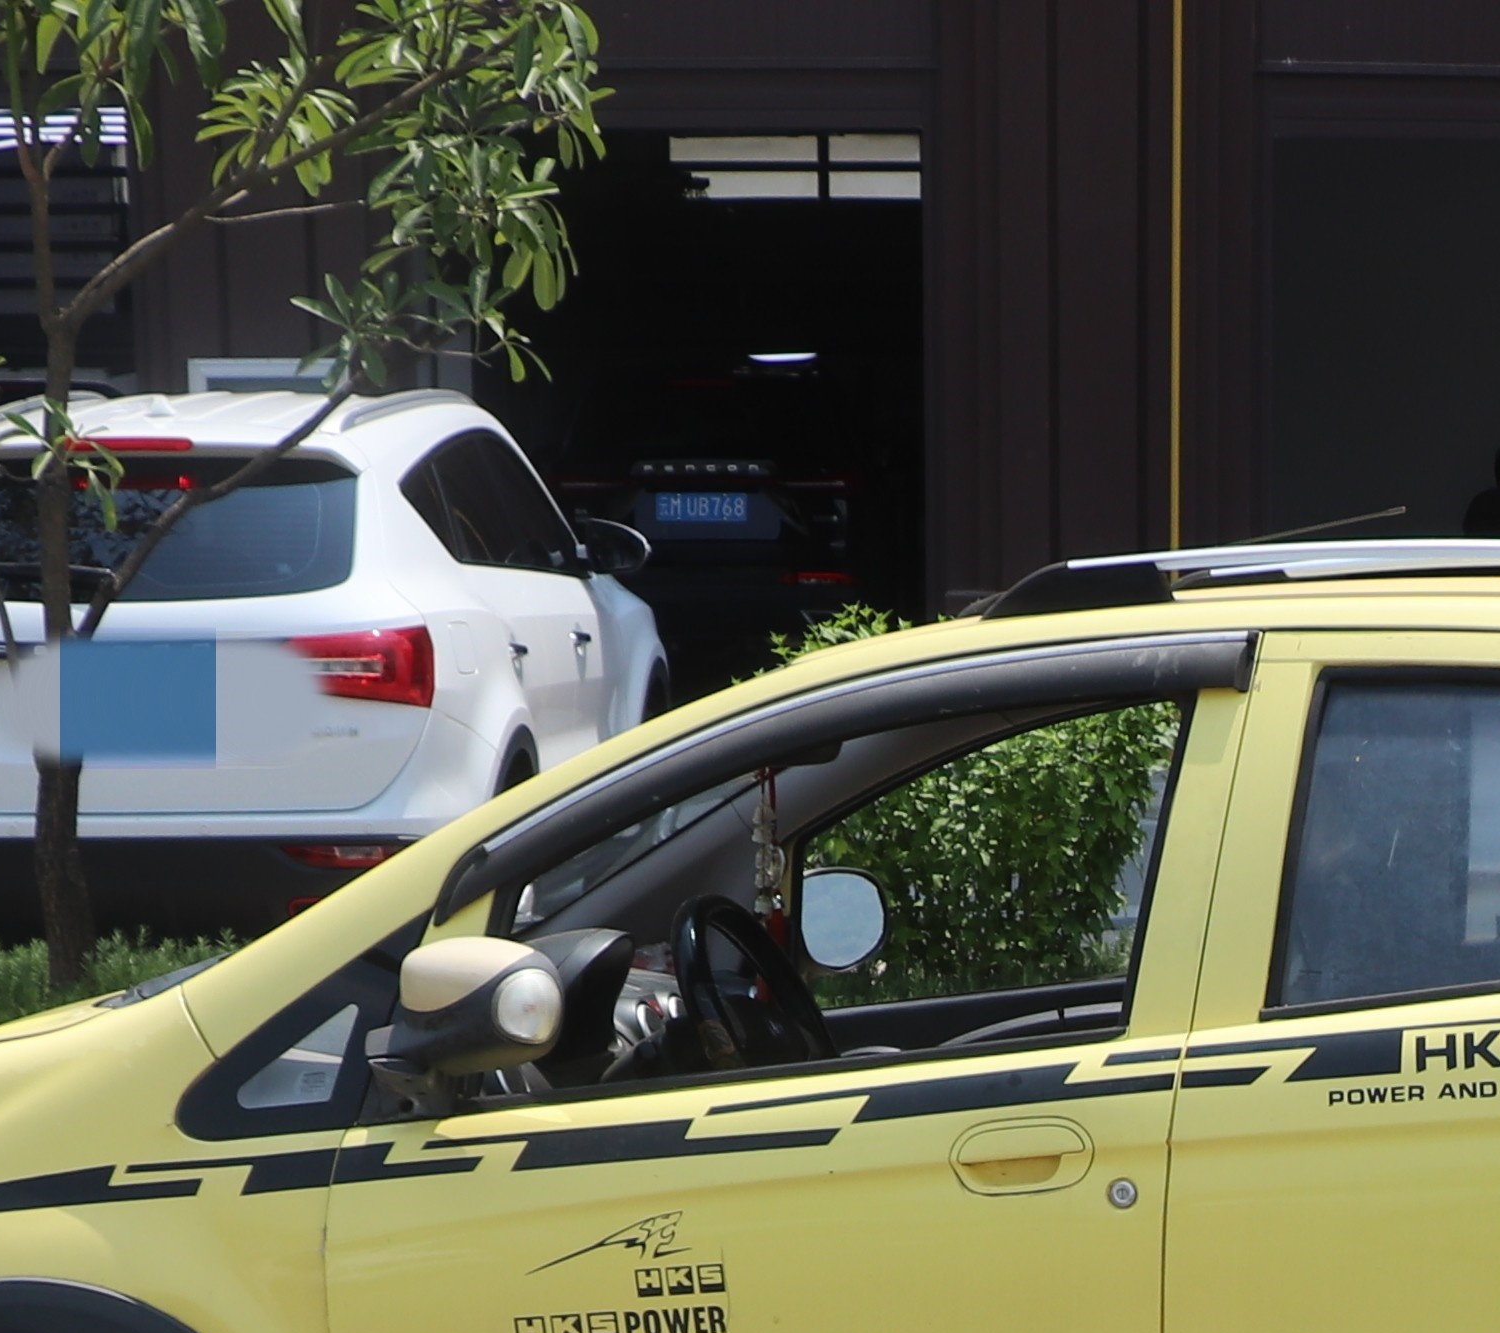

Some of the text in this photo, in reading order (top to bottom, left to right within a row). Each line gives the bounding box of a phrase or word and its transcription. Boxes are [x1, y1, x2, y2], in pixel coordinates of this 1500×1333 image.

[1328, 1084, 1425, 1106] POWER
[1438, 1080, 1498, 1099] AND
[634, 1263, 726, 1298] HKS
